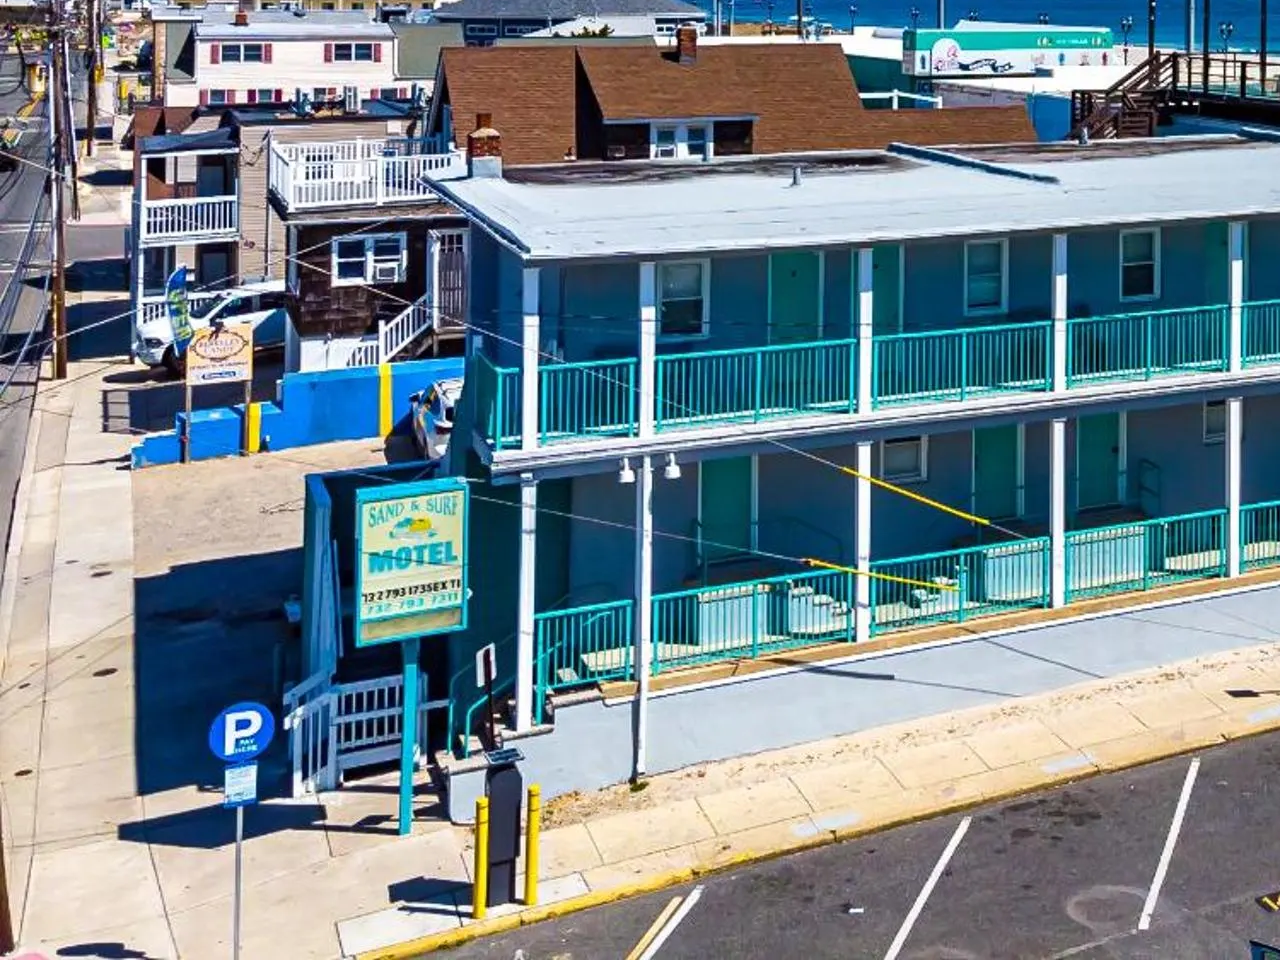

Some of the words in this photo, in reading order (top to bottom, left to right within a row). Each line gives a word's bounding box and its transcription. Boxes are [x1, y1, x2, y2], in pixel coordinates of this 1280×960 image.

[368, 502, 404, 528] SAND
[410, 500, 420, 511] &
[426, 495, 460, 515] SURF
[368, 541, 458, 573] MOTEL
[224, 710, 263, 756] P
